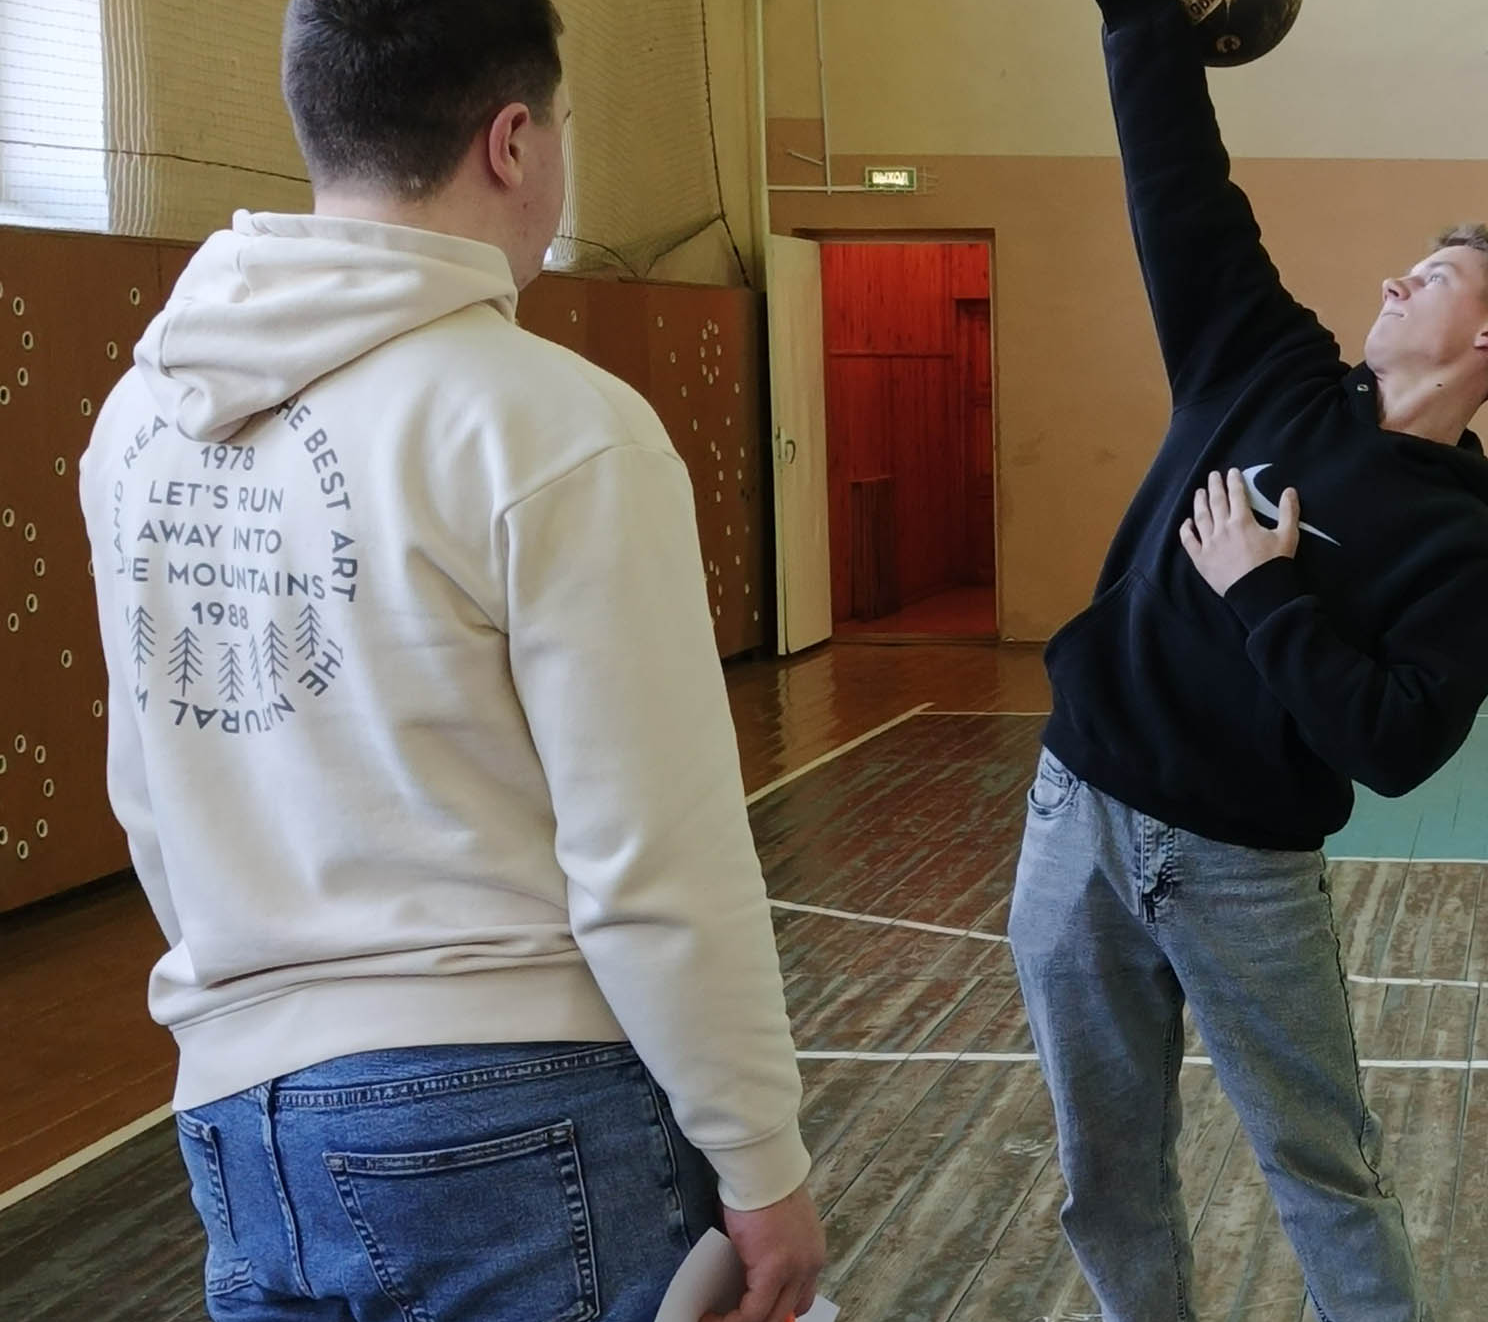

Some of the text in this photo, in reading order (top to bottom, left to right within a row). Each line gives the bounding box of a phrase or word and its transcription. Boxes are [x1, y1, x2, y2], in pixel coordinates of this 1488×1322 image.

[872, 171, 909, 186] ВЫХОД
[200, 444, 255, 472] 1978
[237, 486, 284, 514] RUN
[303, 428, 352, 512] BEST
[331, 529, 358, 603] ART
[136, 519, 282, 554] AWAY INTO
[167, 561, 326, 601] MOUNTAINS
[191, 601, 249, 631] 1988
[297, 638, 343, 697] THE
[168, 694, 297, 735] NATURAL
